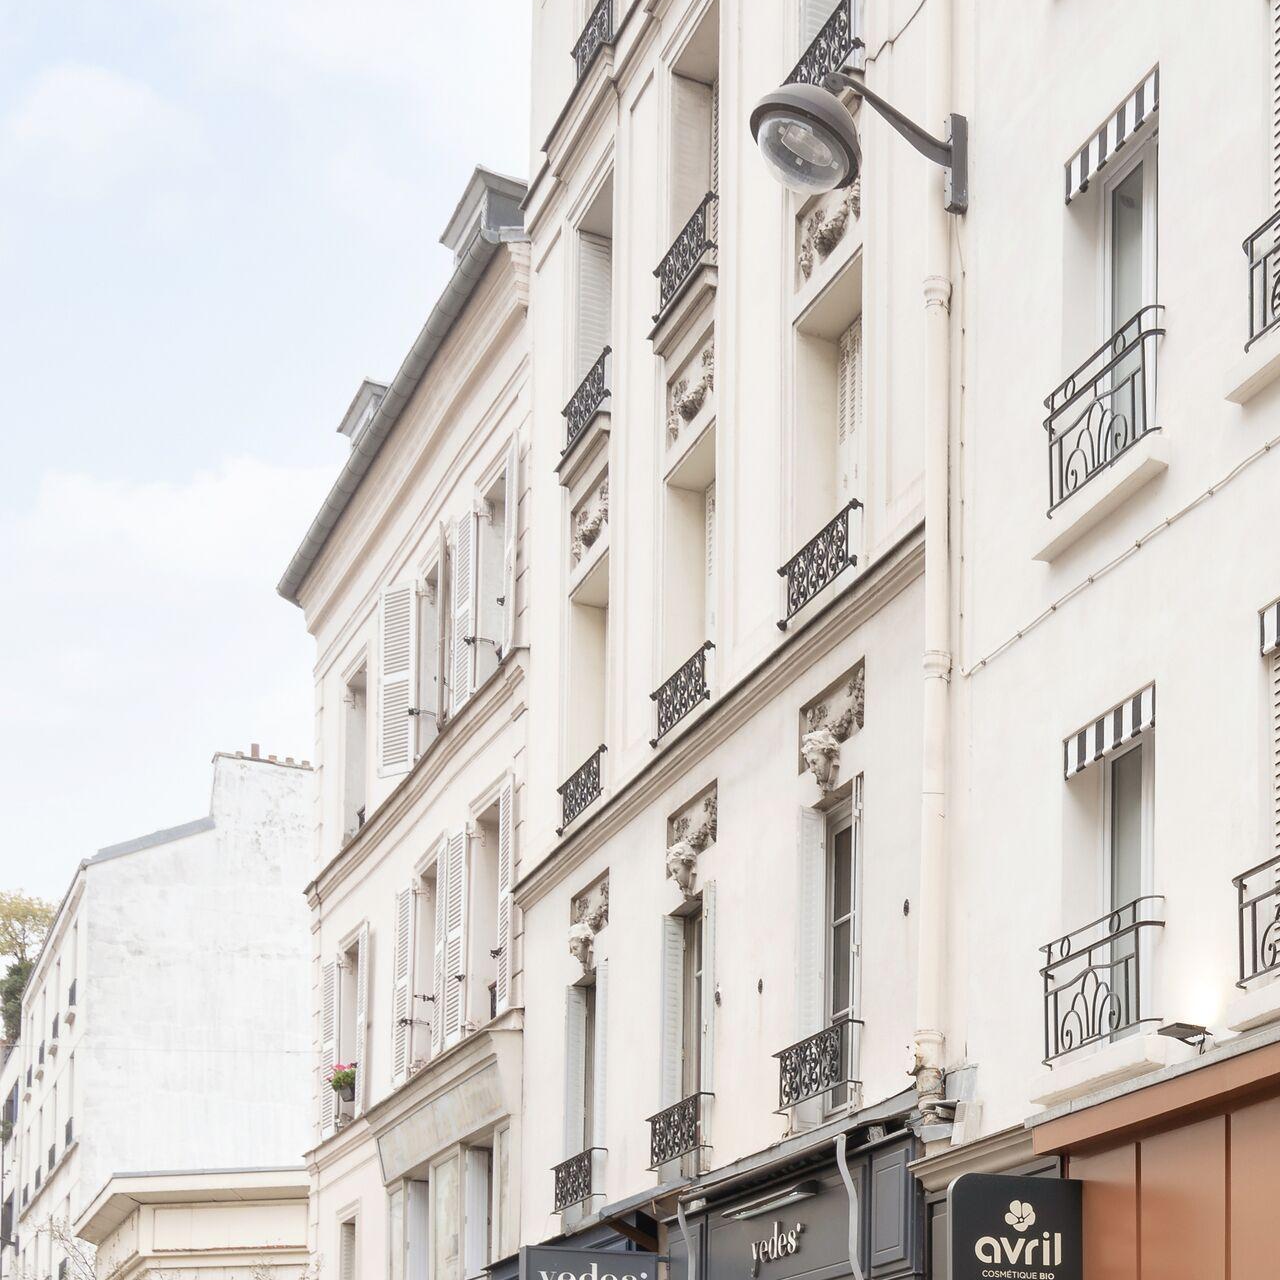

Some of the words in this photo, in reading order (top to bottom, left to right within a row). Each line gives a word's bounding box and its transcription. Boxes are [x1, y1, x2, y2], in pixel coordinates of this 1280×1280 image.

[974, 1231, 1062, 1267] avril
[981, 1269, 1038, 1280] COSMÉTIQUE
[1038, 1271, 1055, 1280] BIO
